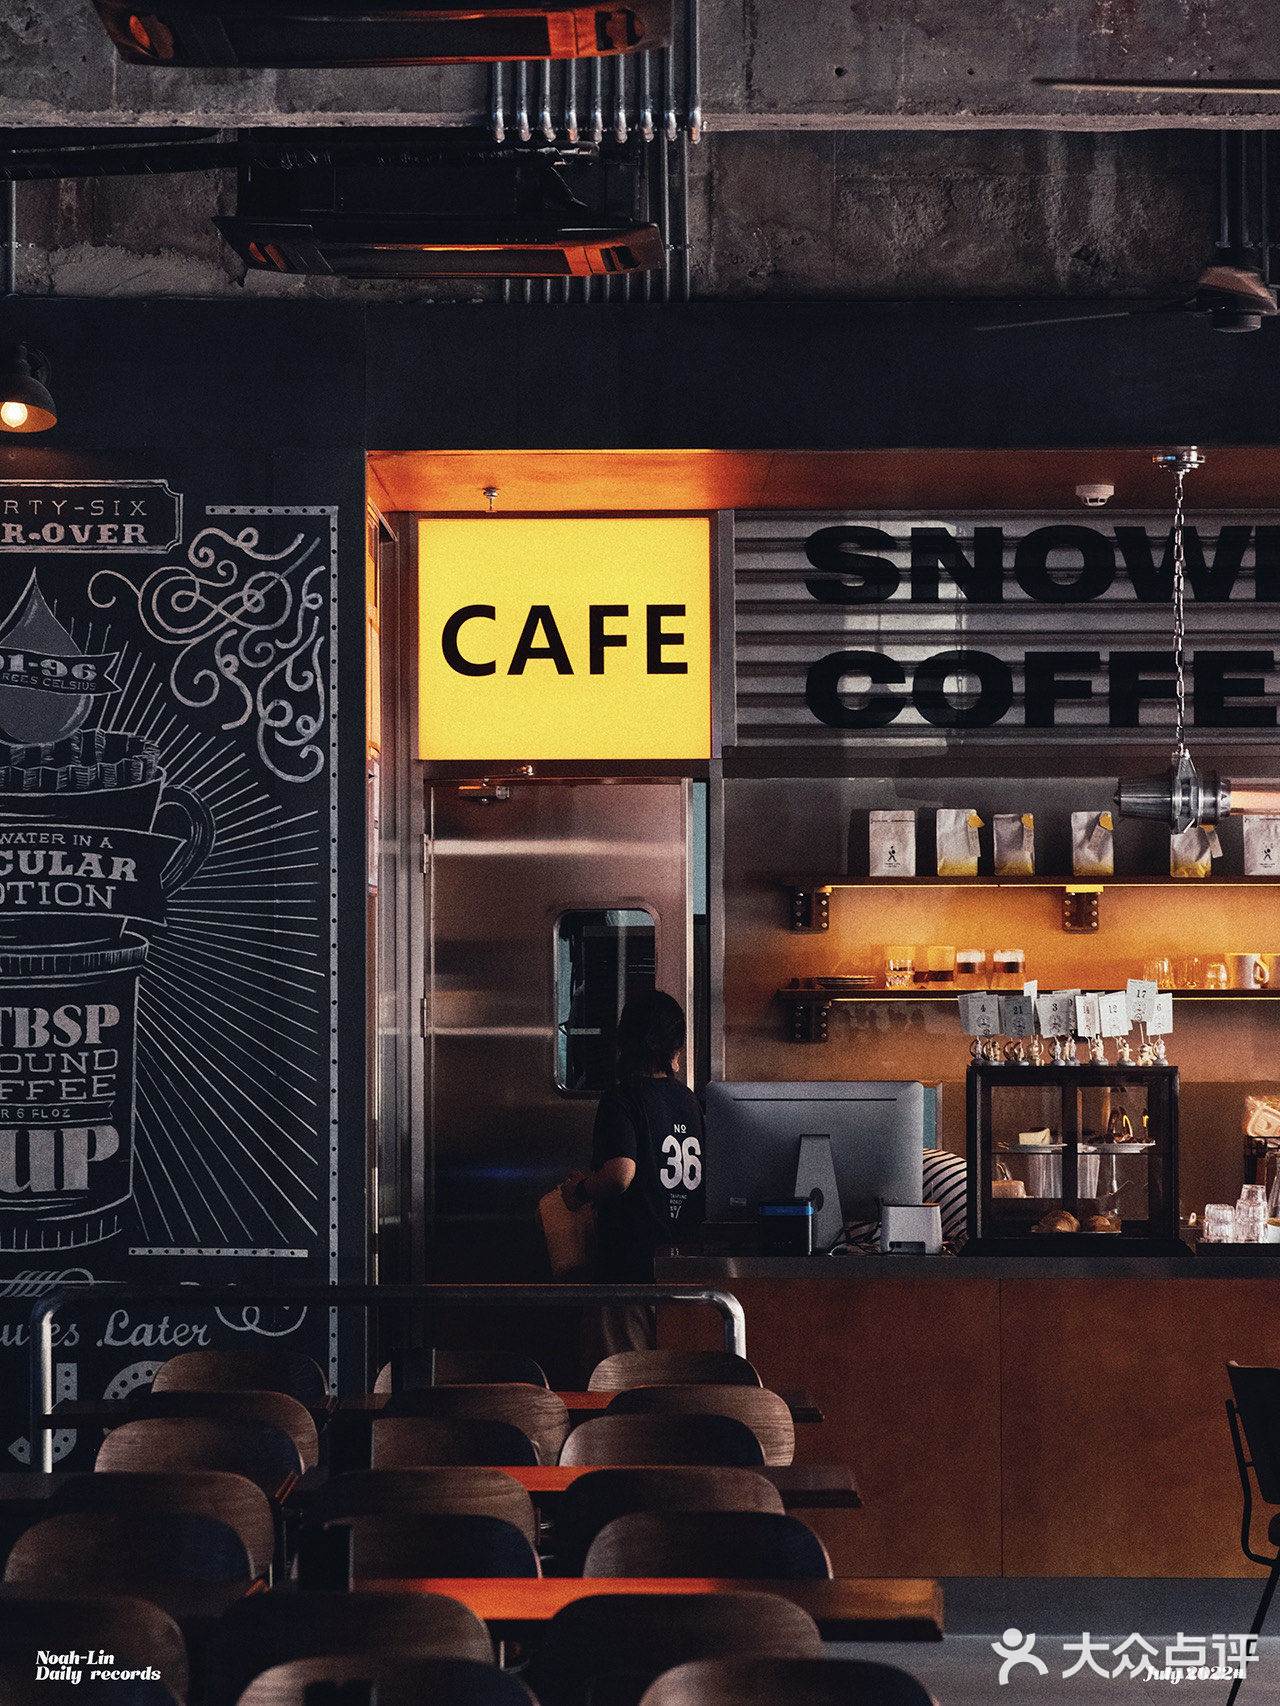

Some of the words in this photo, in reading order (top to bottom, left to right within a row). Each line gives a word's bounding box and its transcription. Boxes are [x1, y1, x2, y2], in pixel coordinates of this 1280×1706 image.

[3, 500, 147, 516] RTY-SIX
[441, 604, 689, 676] CAFE
[0, 654, 97, 681] 1-96
[42, 678, 97, 691] CELSIUS
[73, 834, 92, 847] IN
[100, 836, 114, 849] A
[0, 881, 117, 909] TION
[660, 1134, 702, 1190] 36
[96, 1309, 211, 1347] Later
